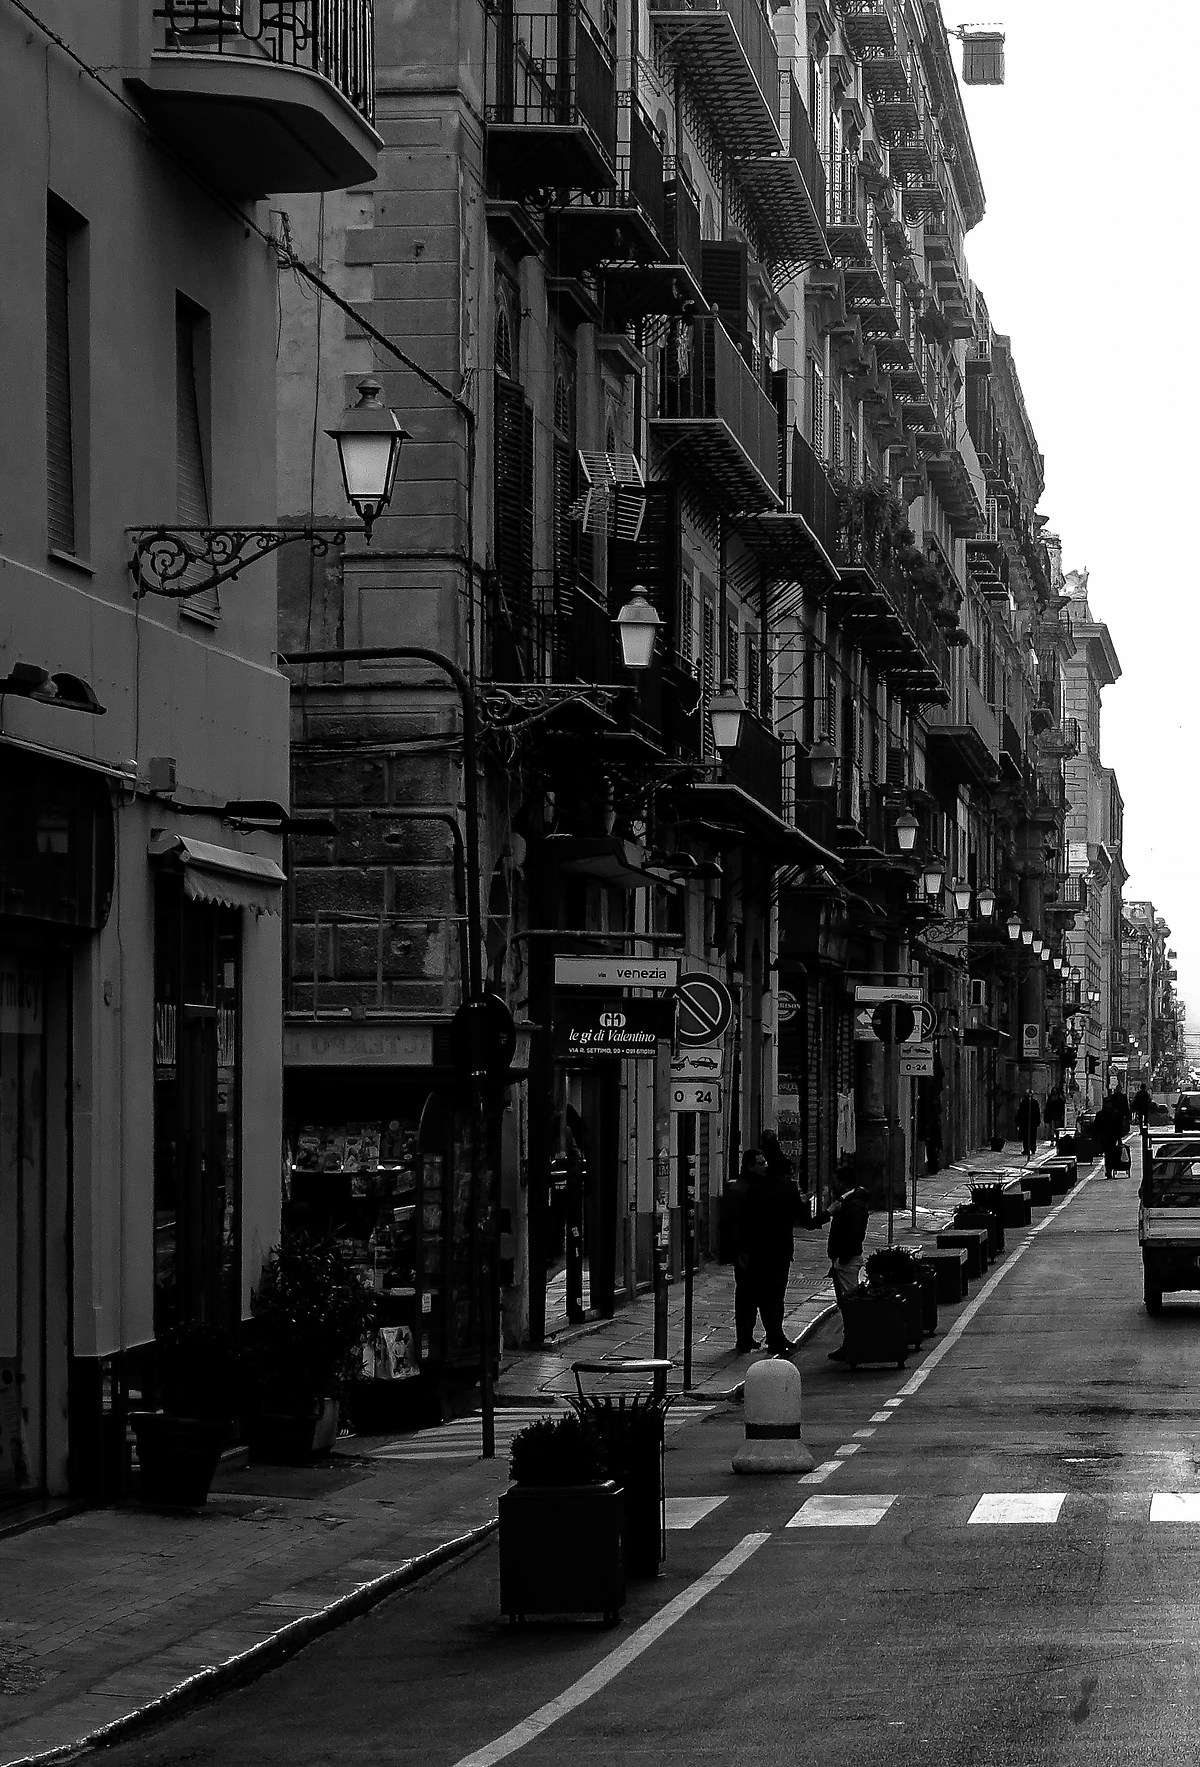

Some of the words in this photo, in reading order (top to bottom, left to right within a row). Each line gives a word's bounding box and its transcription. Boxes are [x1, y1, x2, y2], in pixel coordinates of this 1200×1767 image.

[617, 968, 667, 978] venezia
[569, 1028, 580, 1041] le
[580, 1029, 593, 1044] gi
[593, 1029, 605, 1041] di
[607, 1029, 655, 1042] Valentino
[695, 1091, 712, 1103] 24
